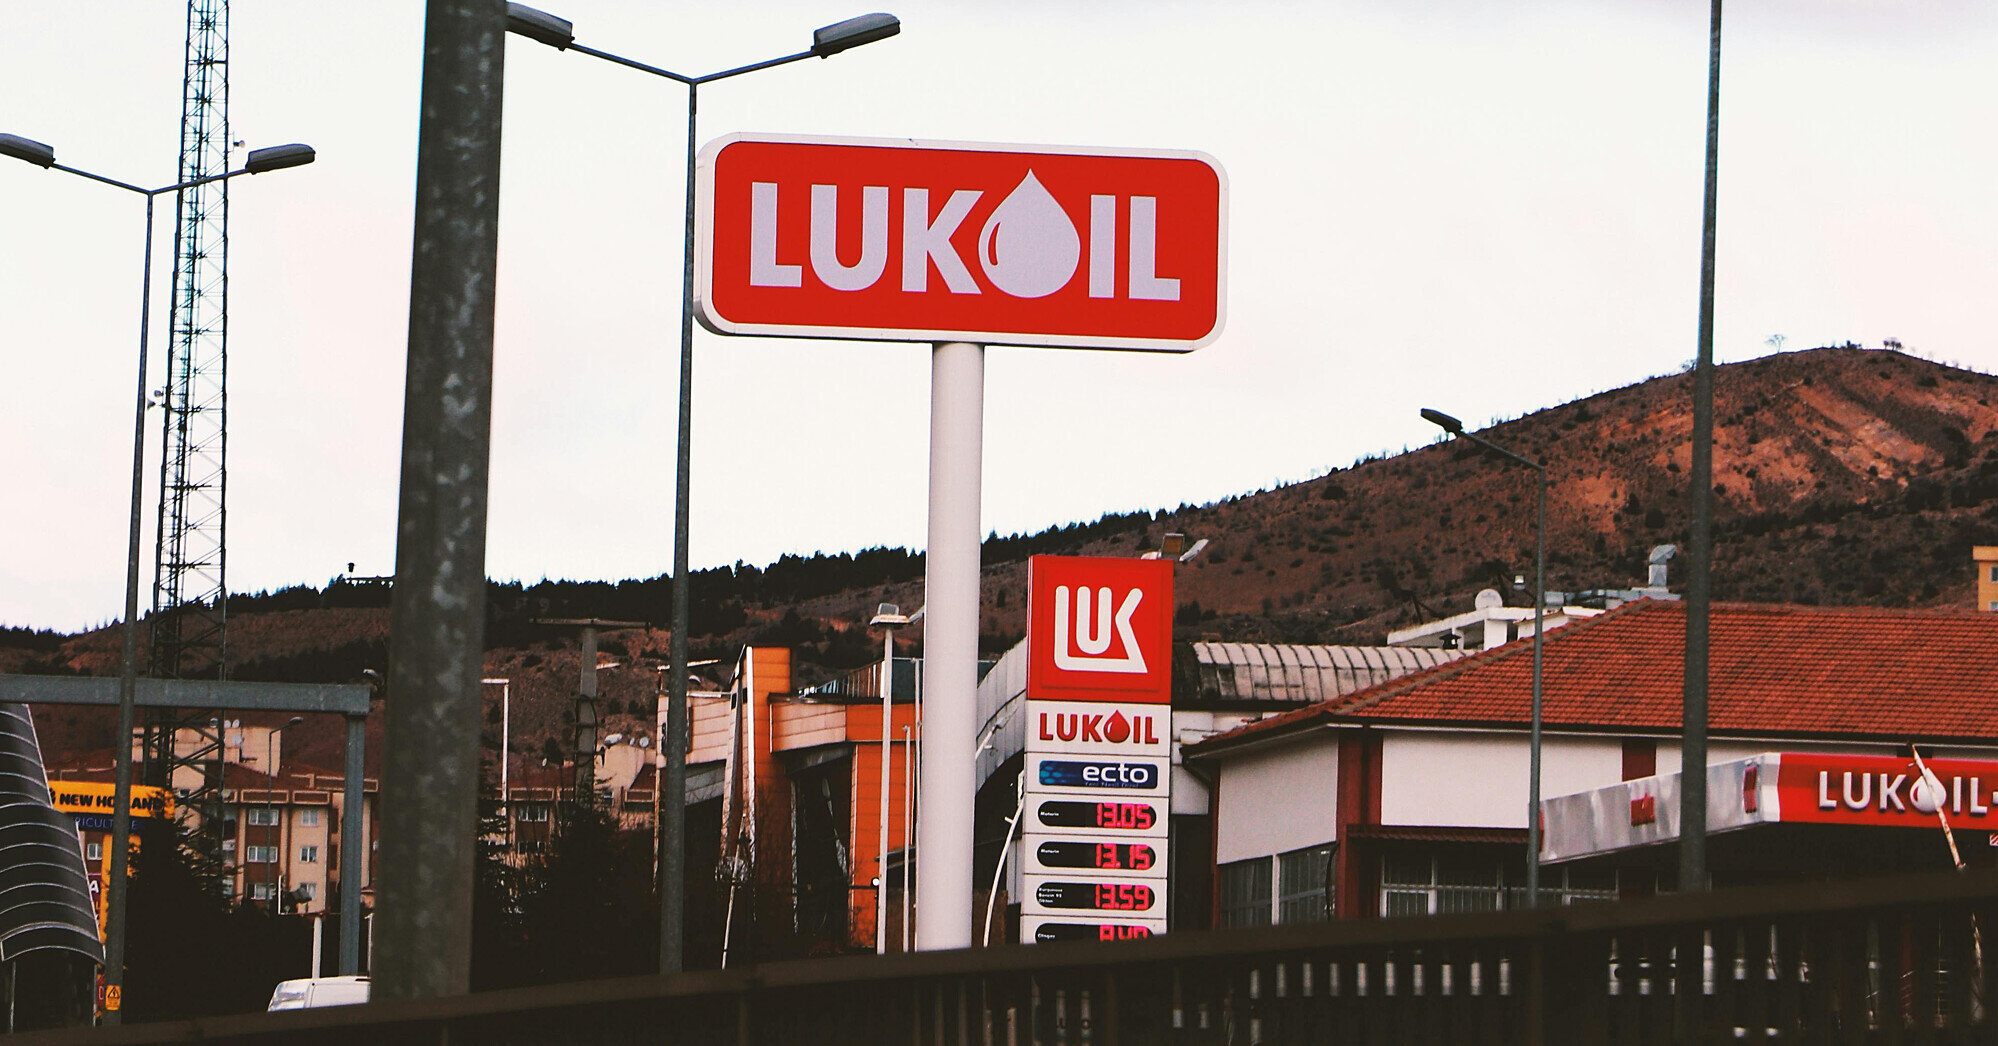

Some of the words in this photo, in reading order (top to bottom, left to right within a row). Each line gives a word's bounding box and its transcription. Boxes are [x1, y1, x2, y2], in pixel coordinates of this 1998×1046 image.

[750, 168, 1181, 302] LUKOIL
[1054, 585, 1148, 673] LUK
[1039, 709, 1159, 745] LUKOIL
[1082, 761, 1149, 783] ecto
[59, 793, 93, 807] NEW
[1097, 802, 1151, 830] 13.05
[1096, 843, 1150, 870] 13.15
[1095, 884, 1149, 911] 13.59
